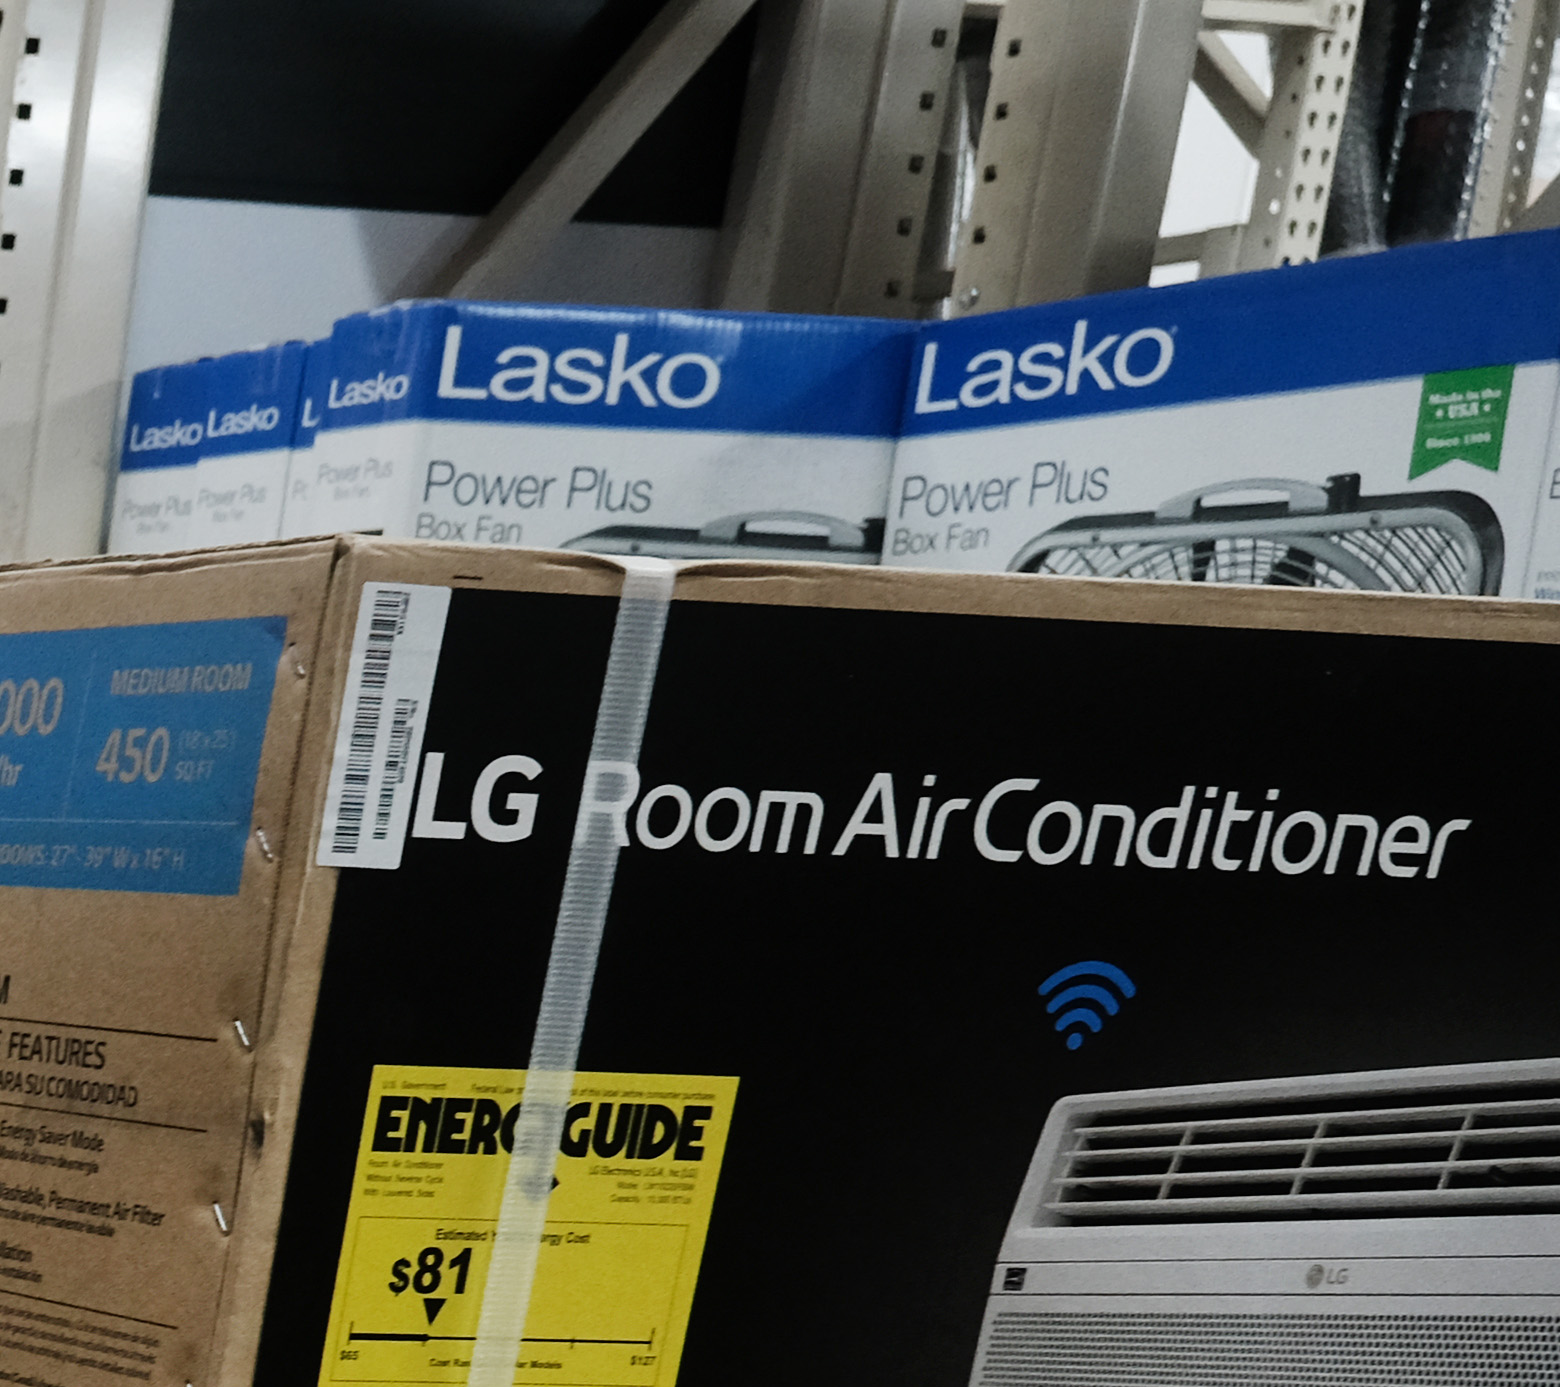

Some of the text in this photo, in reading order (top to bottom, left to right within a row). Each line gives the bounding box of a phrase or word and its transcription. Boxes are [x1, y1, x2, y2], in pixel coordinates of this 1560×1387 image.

[437, 324, 721, 408] Lasko
[914, 319, 1175, 414] Lasko
[328, 371, 409, 409] Lasko
[130, 419, 203, 452] Lasko
[207, 404, 280, 438] Lasko
[424, 460, 653, 514] Power Plus
[899, 461, 1110, 519] Power Plus
[415, 512, 523, 544] Box Fan
[892, 522, 990, 556] Box Fan
[109, 662, 254, 699] MEDIUM ROOM
[94, 726, 170, 785] 450
[411, 750, 544, 843] LG
[571, 759, 825, 855] Room
[7, 1031, 108, 1070] FEATURES
[46, 1074, 138, 1108] COMODIDAD
[388, 1246, 474, 1298] $81
